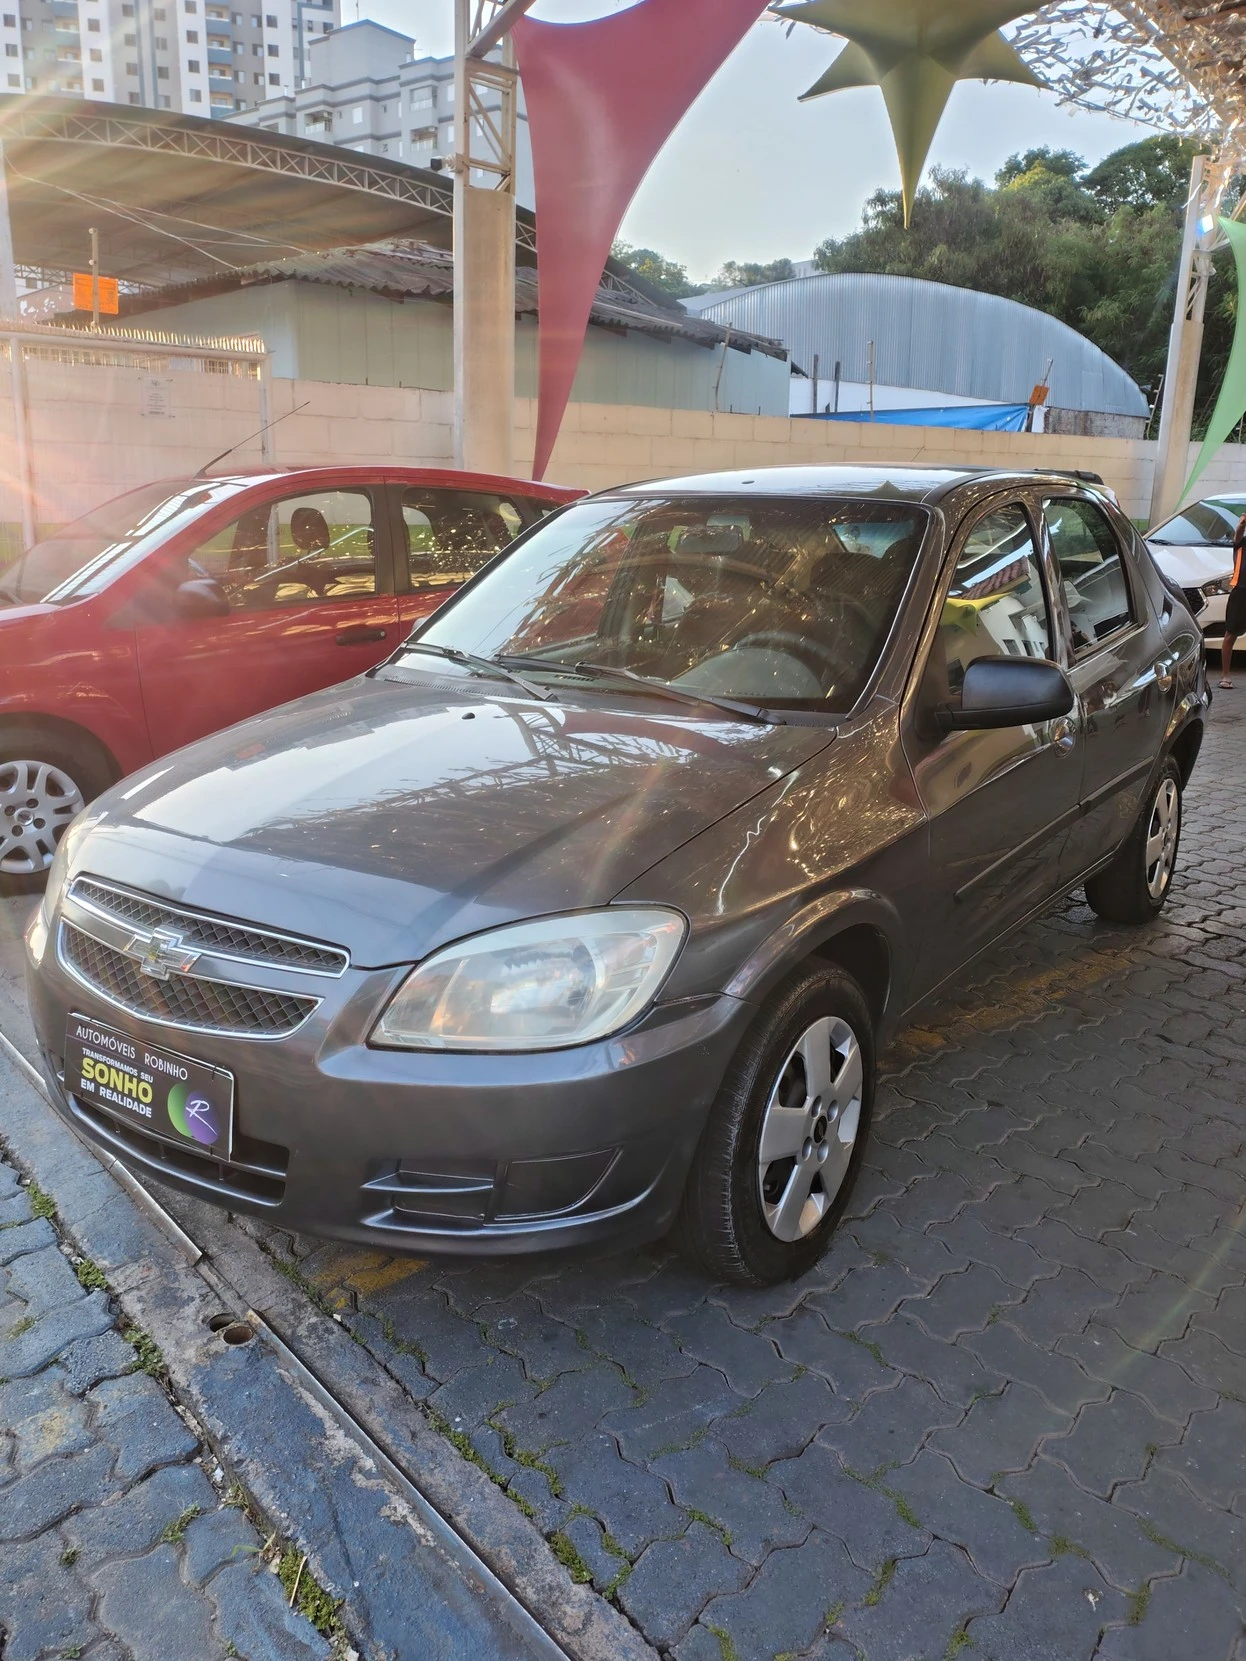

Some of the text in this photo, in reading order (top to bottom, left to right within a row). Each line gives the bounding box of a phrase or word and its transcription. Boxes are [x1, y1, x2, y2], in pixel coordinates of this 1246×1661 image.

[76, 1025, 188, 1080] AUTOMÓVEIS ROBINHO
[82, 1047, 154, 1083] TRANSFORMAMOS SEU
[80, 1078, 152, 1118] EM REALIDADE
[81, 1057, 153, 1104] SONHO
